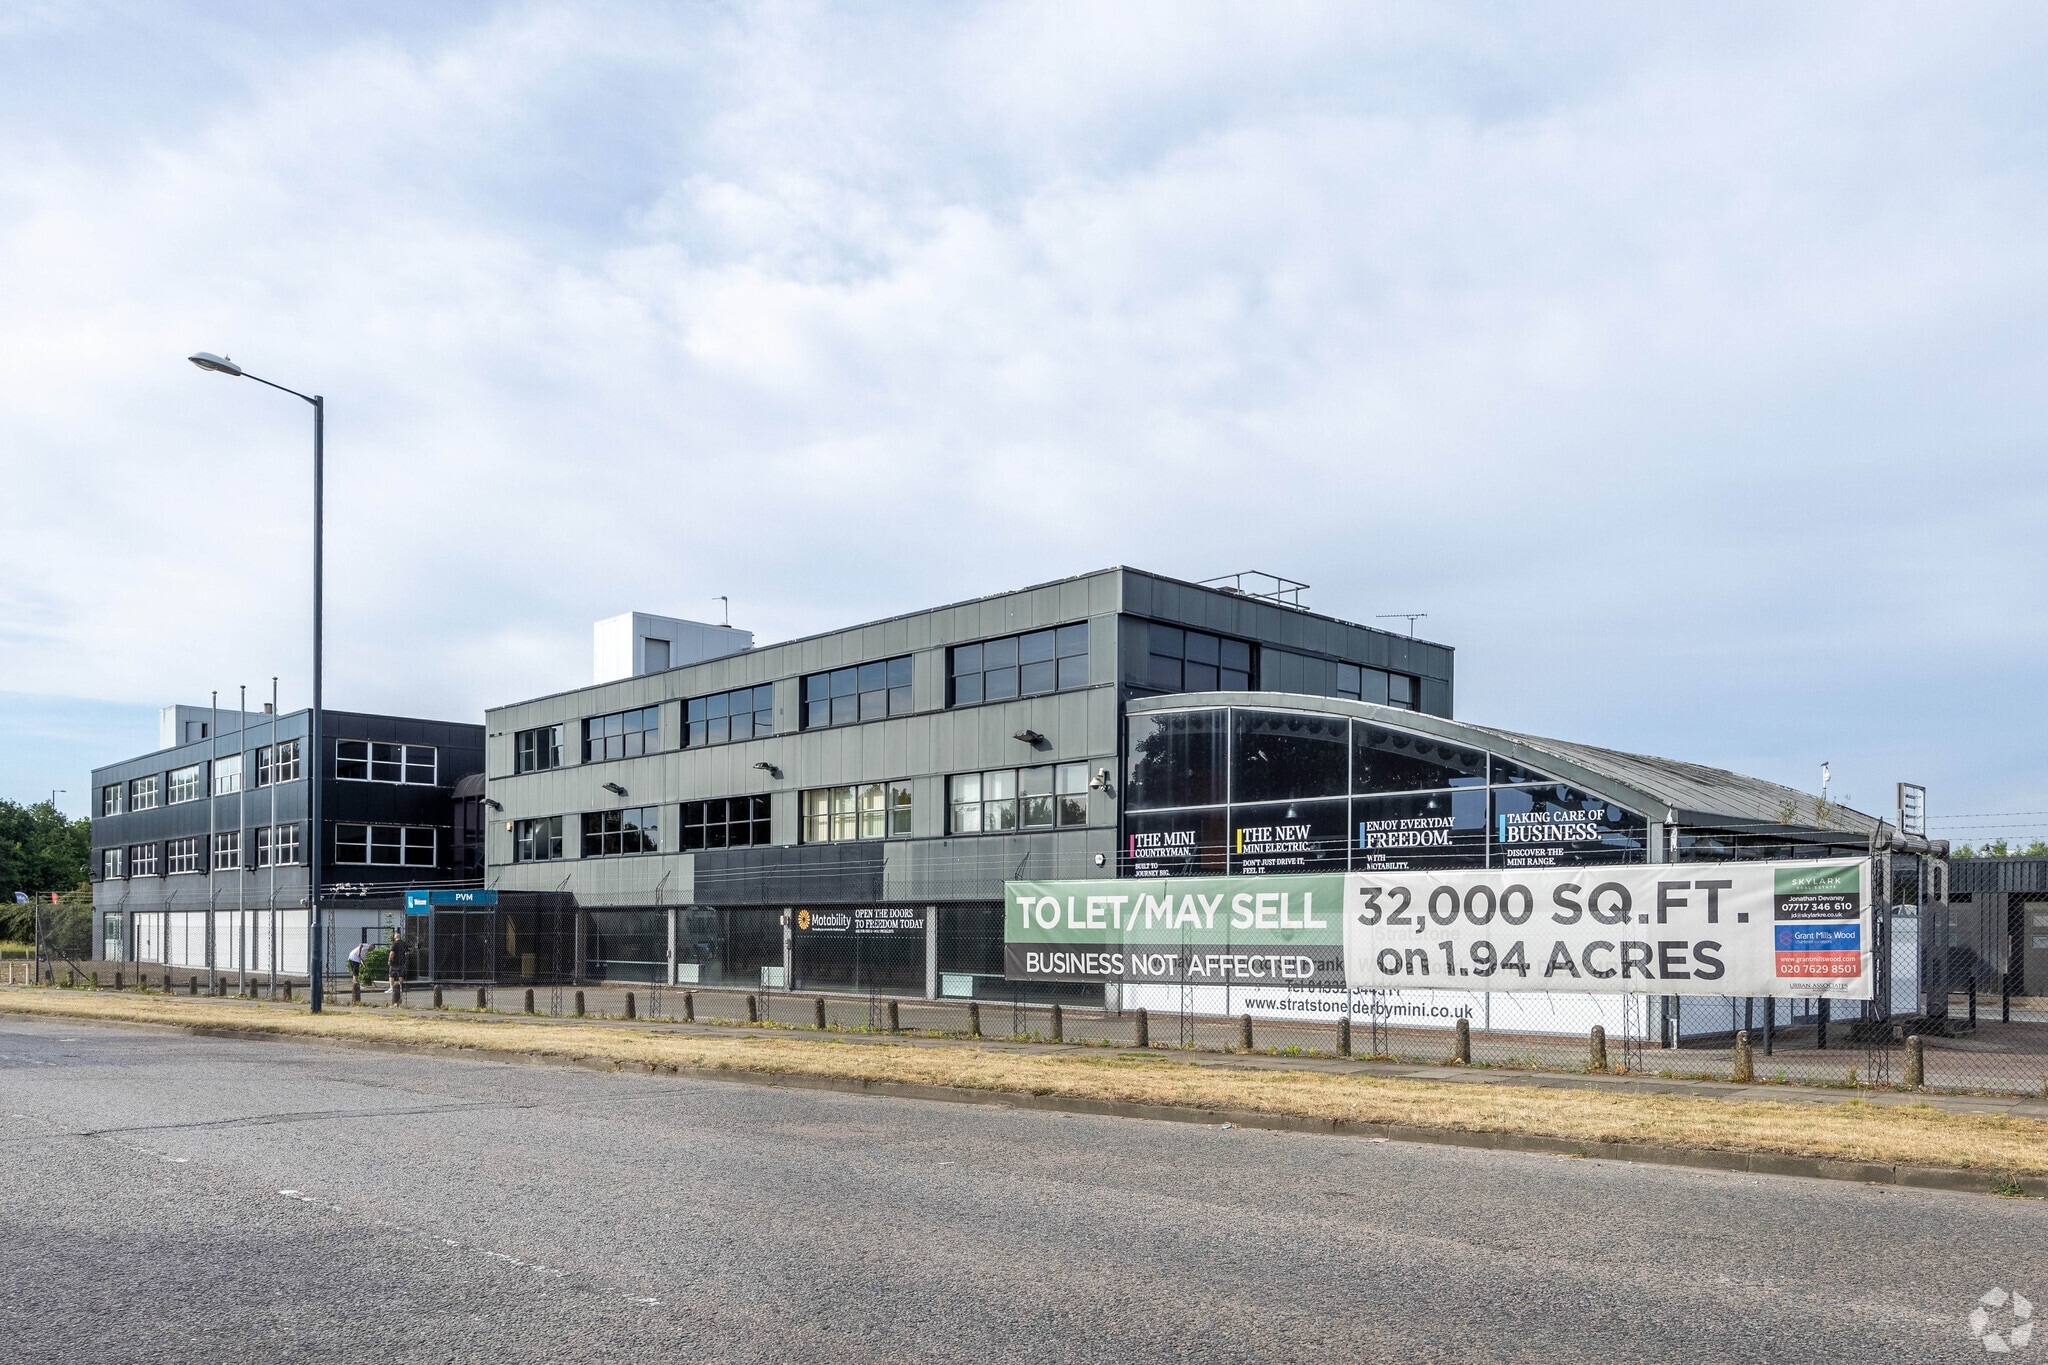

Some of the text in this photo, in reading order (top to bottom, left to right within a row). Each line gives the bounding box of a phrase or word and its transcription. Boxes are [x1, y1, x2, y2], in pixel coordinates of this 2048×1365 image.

[1507, 809, 1605, 824] TAKING CARE OF
[1366, 817, 1456, 832] ENJOY EVERYDAY
[1243, 825, 1311, 843] THE NEW
[1366, 830, 1453, 848] FREEDOM.
[1507, 823, 1603, 843] BUSINESS.
[1135, 831, 1196, 848] THE MINI
[1135, 847, 1191, 858] COUNTRYMAN.
[1243, 841, 1311, 854] MINI ELECTRIC.
[1507, 848, 1564, 857] DISCOVER THE
[1262, 858, 1275, 866] JUST
[1276, 857, 1296, 866] DRIVE
[1507, 857, 1556, 866] MINI RANGE.
[1243, 867, 1257, 875] FEEL
[1791, 877, 1841, 886] SKYLARK
[455, 893, 473, 901] PVM
[1016, 896, 1061, 930] TO
[1231, 891, 1327, 930] SELL
[1357, 884, 1534, 934] 32,000
[1782, 902, 1852, 911] 07717 346 610
[855, 909, 914, 918] OPEN THE DOORS
[812, 913, 851, 929] Motability
[855, 919, 924, 928] TO FREEDOM TODAY
[1833, 931, 1856, 939] Wood
[1026, 952, 1124, 975] BUSINESS
[1132, 953, 1178, 976] NOT
[1188, 954, 1315, 979] AFFECTED
[1377, 948, 1430, 976] on
[1438, 940, 1530, 978] 1.94
[1544, 940, 1725, 980] ACRES
[1780, 964, 1857, 973] 020 7629 8501
